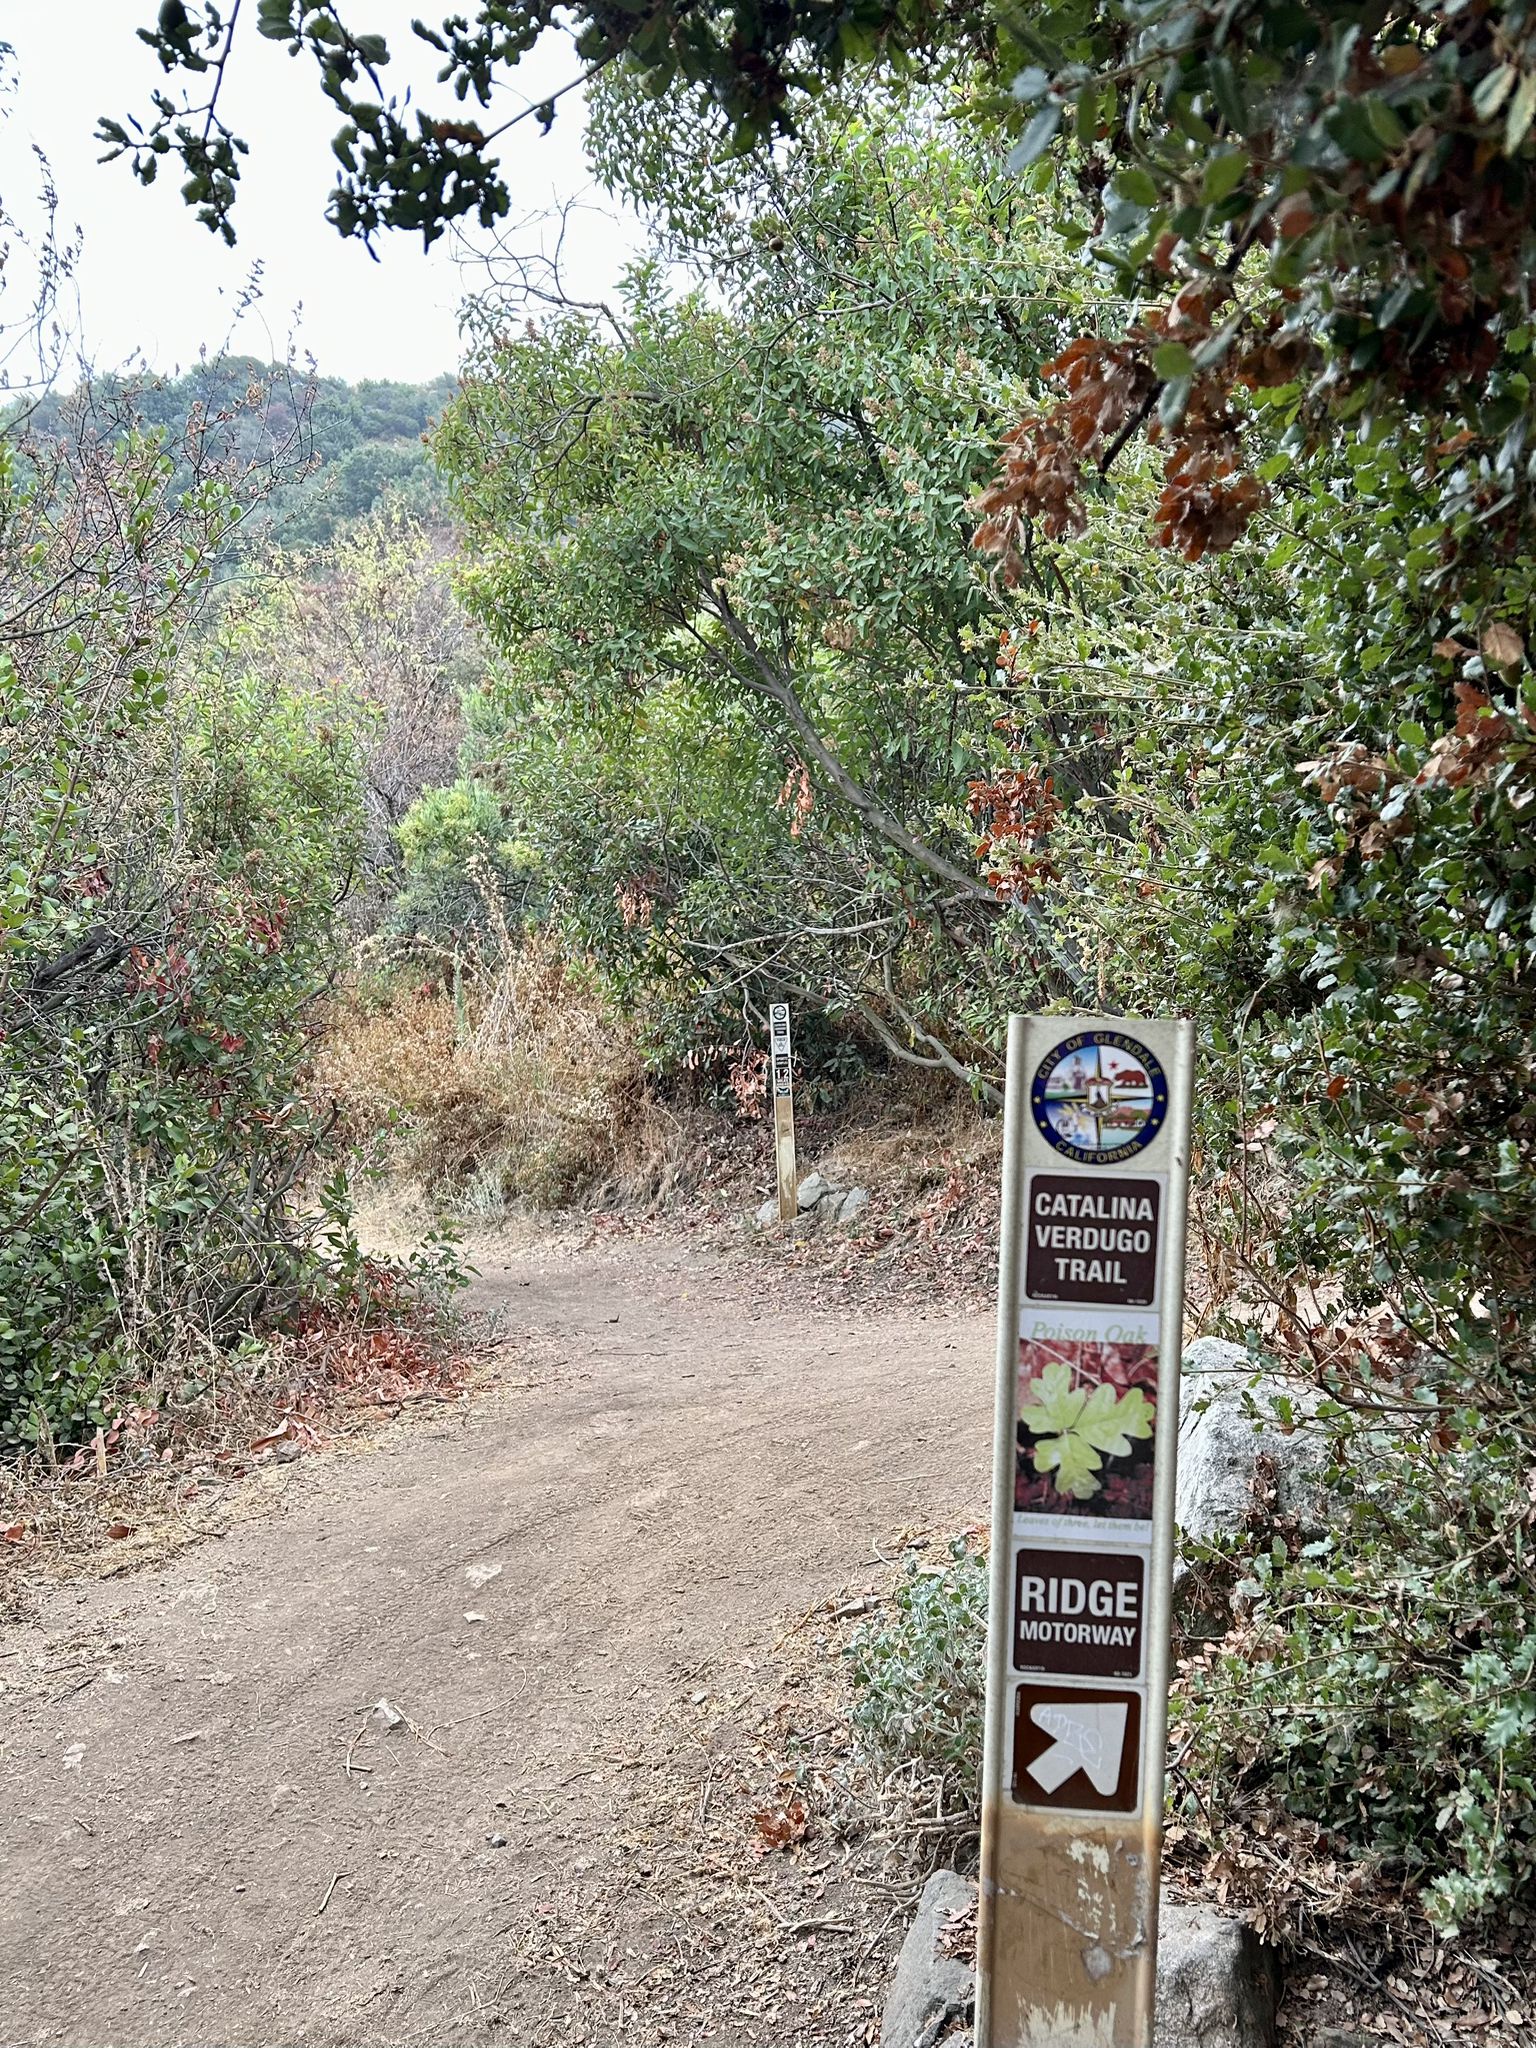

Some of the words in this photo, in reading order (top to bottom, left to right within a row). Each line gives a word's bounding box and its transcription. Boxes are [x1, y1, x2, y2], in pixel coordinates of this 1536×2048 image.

[1038, 1049, 1062, 1080] CITY
[1066, 1035, 1085, 1051] OF
[1093, 1032, 1161, 1078] GLENDALE
[1055, 1140, 1143, 1163] CALIFORNIA
[1034, 1192, 1154, 1221] CATALINA
[1034, 1224, 1151, 1253] VERDUGO
[1054, 1257, 1127, 1284] TRAIL
[1030, 1320, 1098, 1341] Poison
[1104, 1323, 1148, 1343] Oak
[1020, 1575, 1138, 1618] RIDGE
[1020, 1620, 1137, 1647] MOTORWAY
